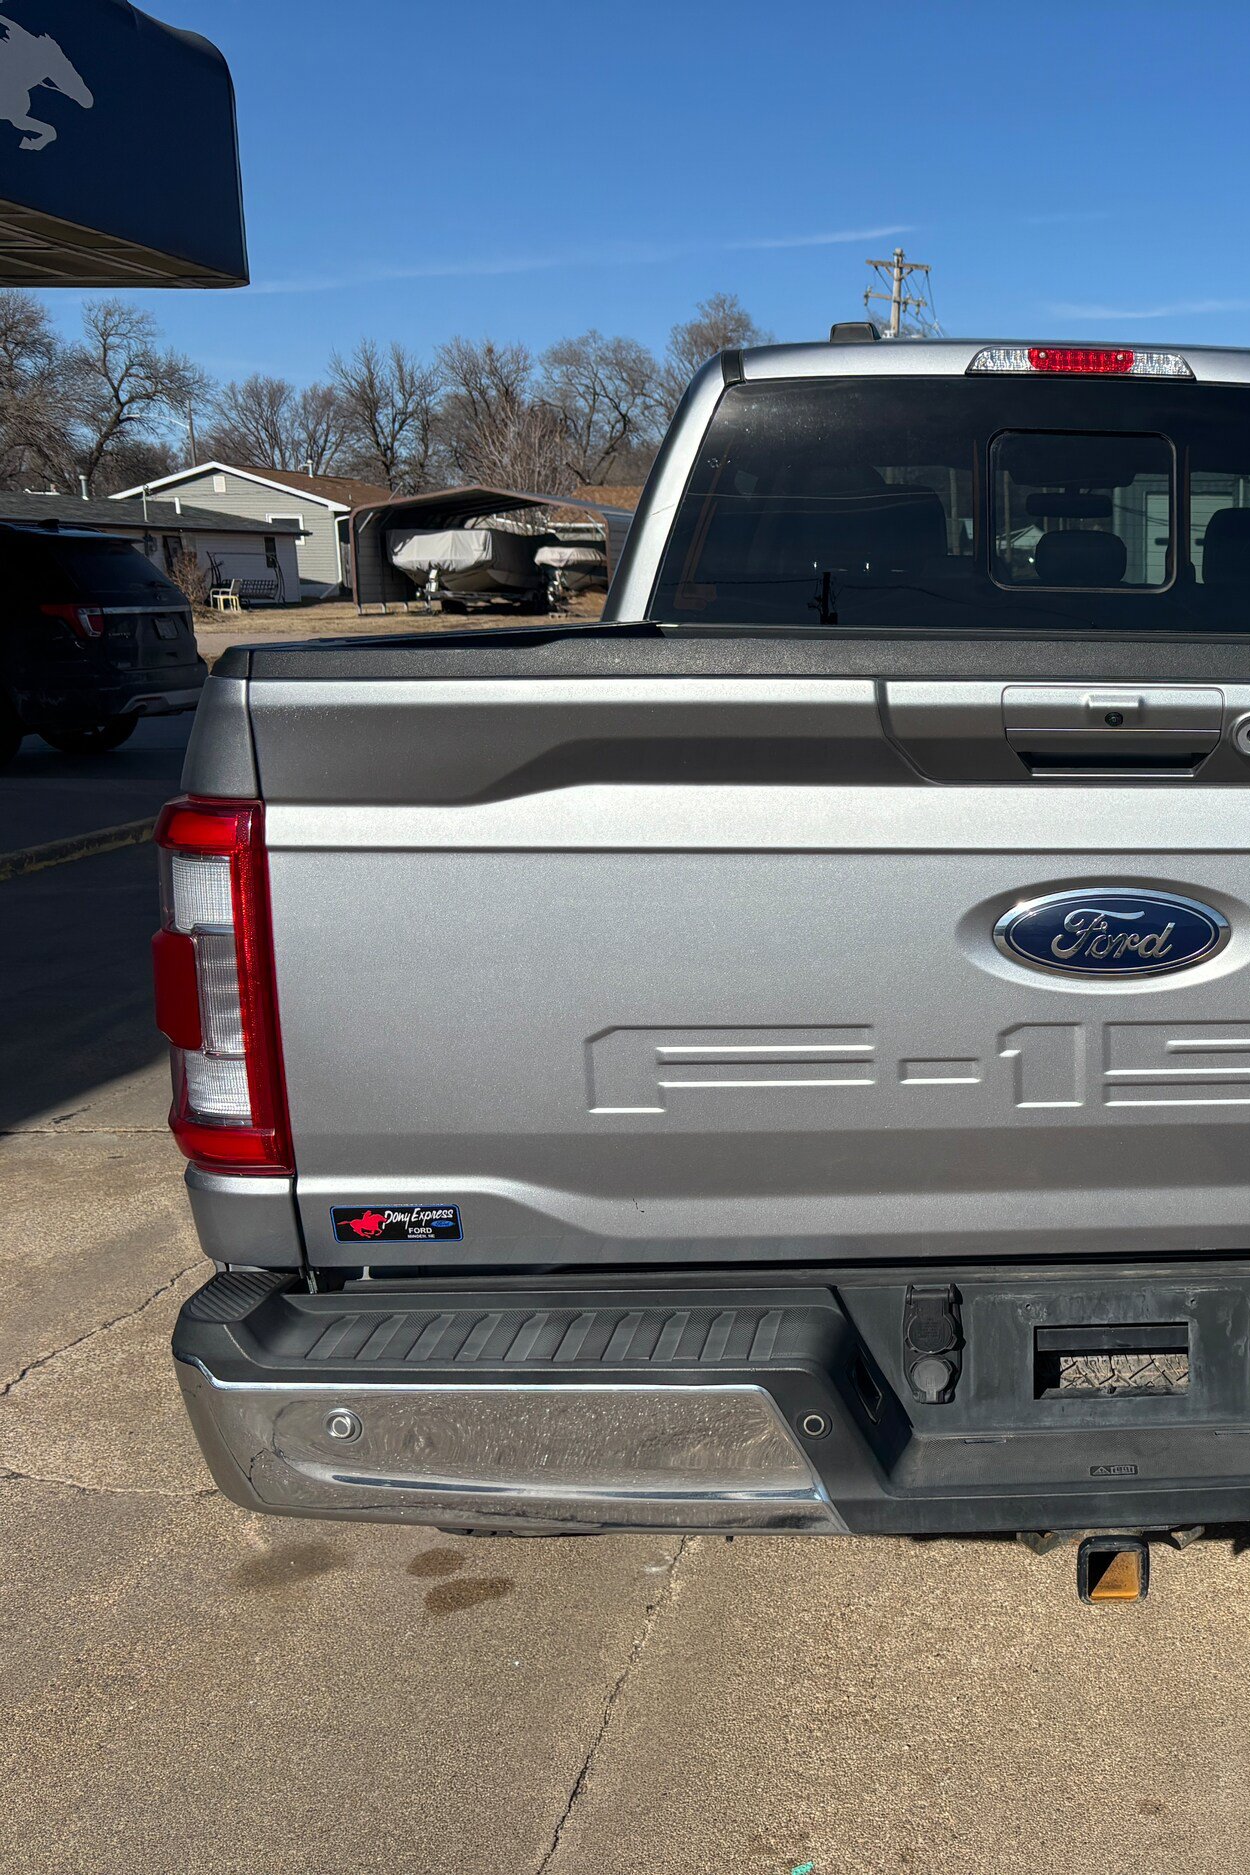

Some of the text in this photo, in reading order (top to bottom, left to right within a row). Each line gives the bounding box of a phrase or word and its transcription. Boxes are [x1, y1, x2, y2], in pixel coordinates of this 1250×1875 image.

[1051, 908, 1176, 960] Ford
[381, 1207, 454, 1230] Pony Express
